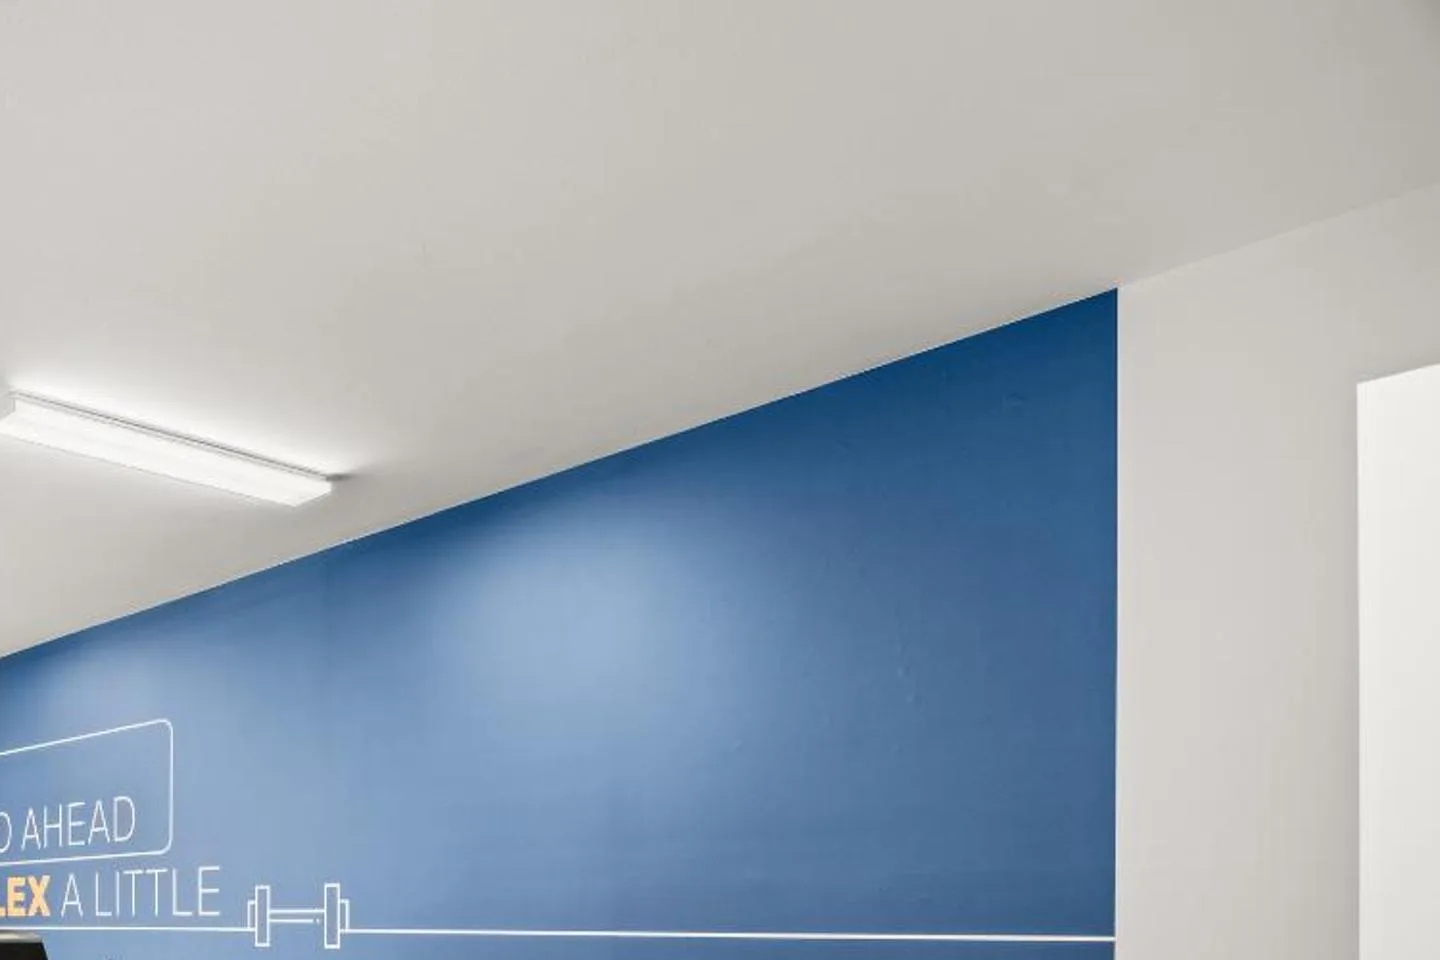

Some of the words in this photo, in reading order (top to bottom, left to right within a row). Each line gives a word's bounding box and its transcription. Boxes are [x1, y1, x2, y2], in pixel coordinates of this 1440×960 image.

[21, 795, 136, 852] AHEAD
[60, 872, 85, 918] A
[94, 865, 222, 918] LITTLE
